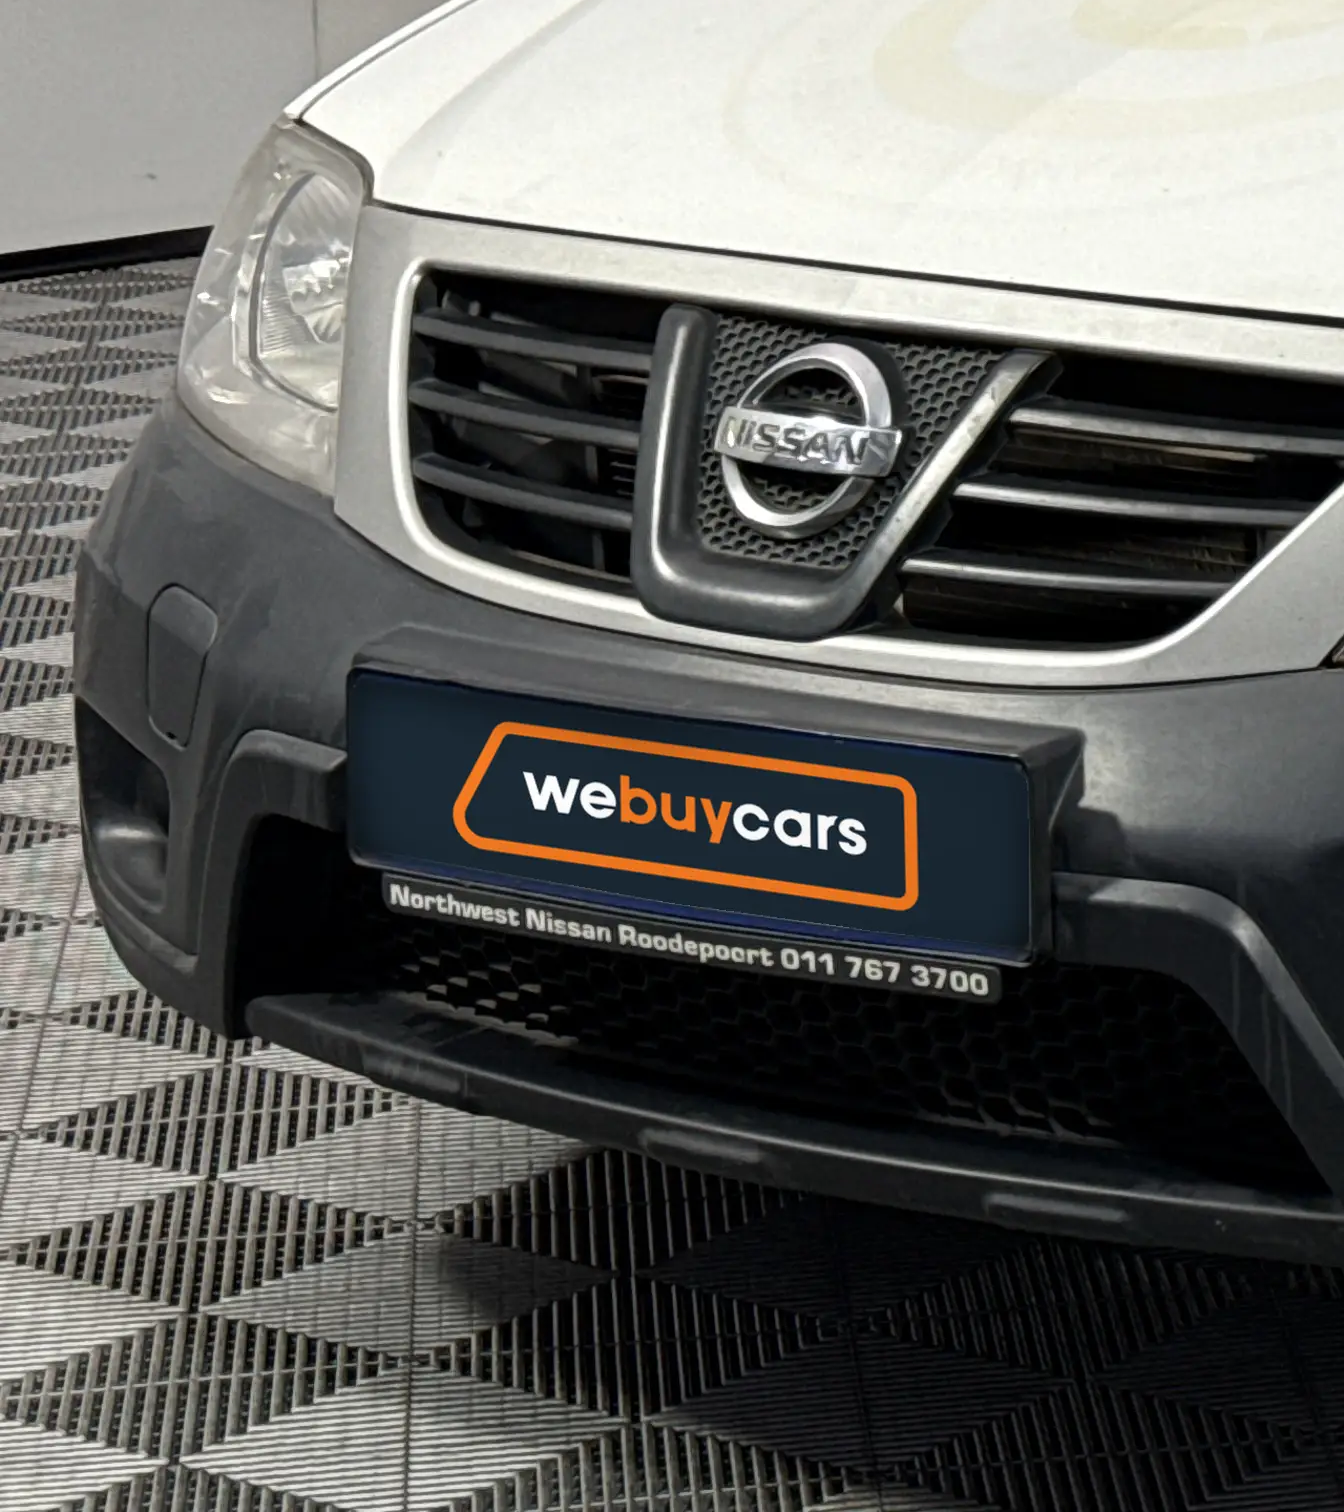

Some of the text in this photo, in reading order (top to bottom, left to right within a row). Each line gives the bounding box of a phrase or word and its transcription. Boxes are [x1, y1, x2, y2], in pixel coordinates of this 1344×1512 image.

[723, 415, 870, 466] NISSAN
[389, 883, 989, 996] Northwest Nissan Roodepoort 011 767 3700
